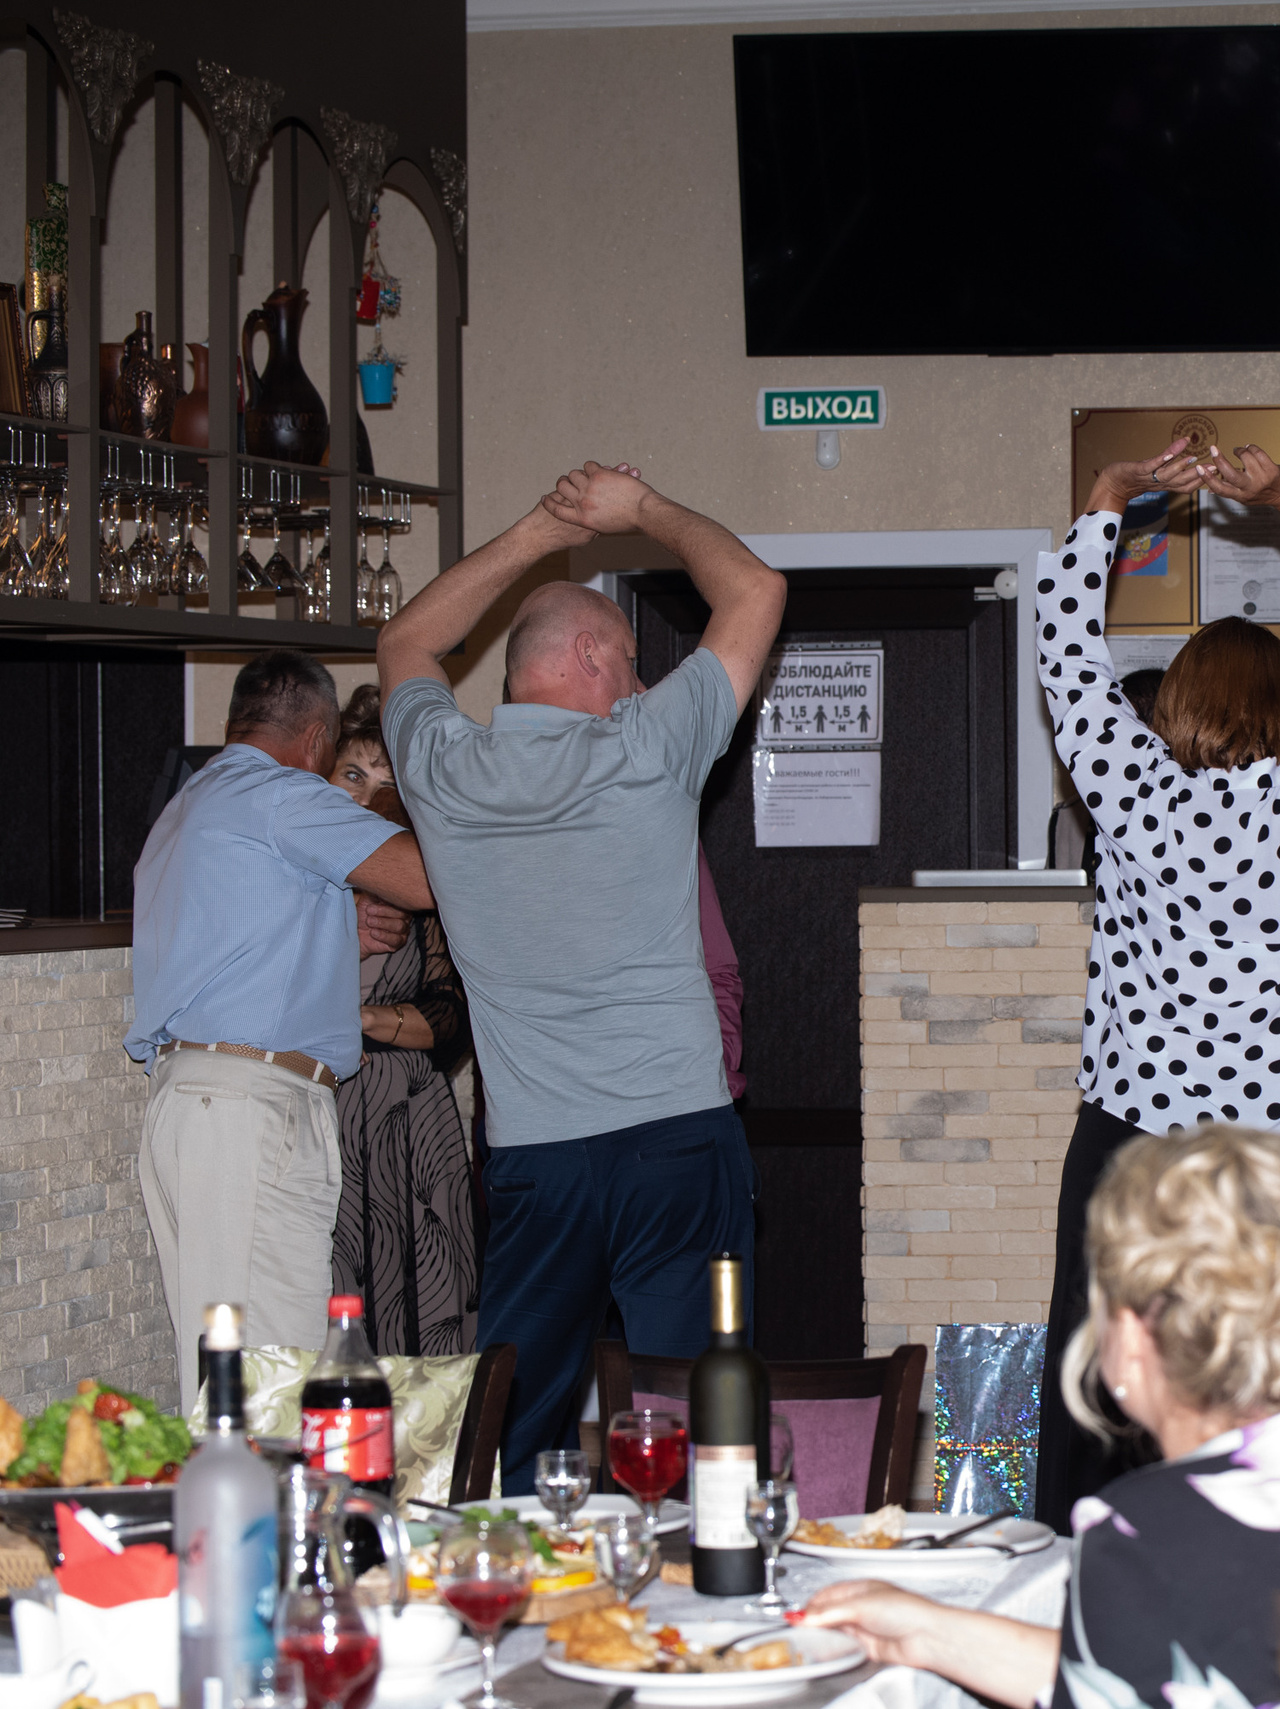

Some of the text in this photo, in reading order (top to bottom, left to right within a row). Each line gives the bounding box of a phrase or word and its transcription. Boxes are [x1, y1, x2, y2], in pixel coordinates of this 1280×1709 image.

[772, 396, 874, 420] ВЫХОД
[772, 684, 867, 701] ДИСТАНЦИЮ
[790, 705, 850, 719] 1,5 1,5
